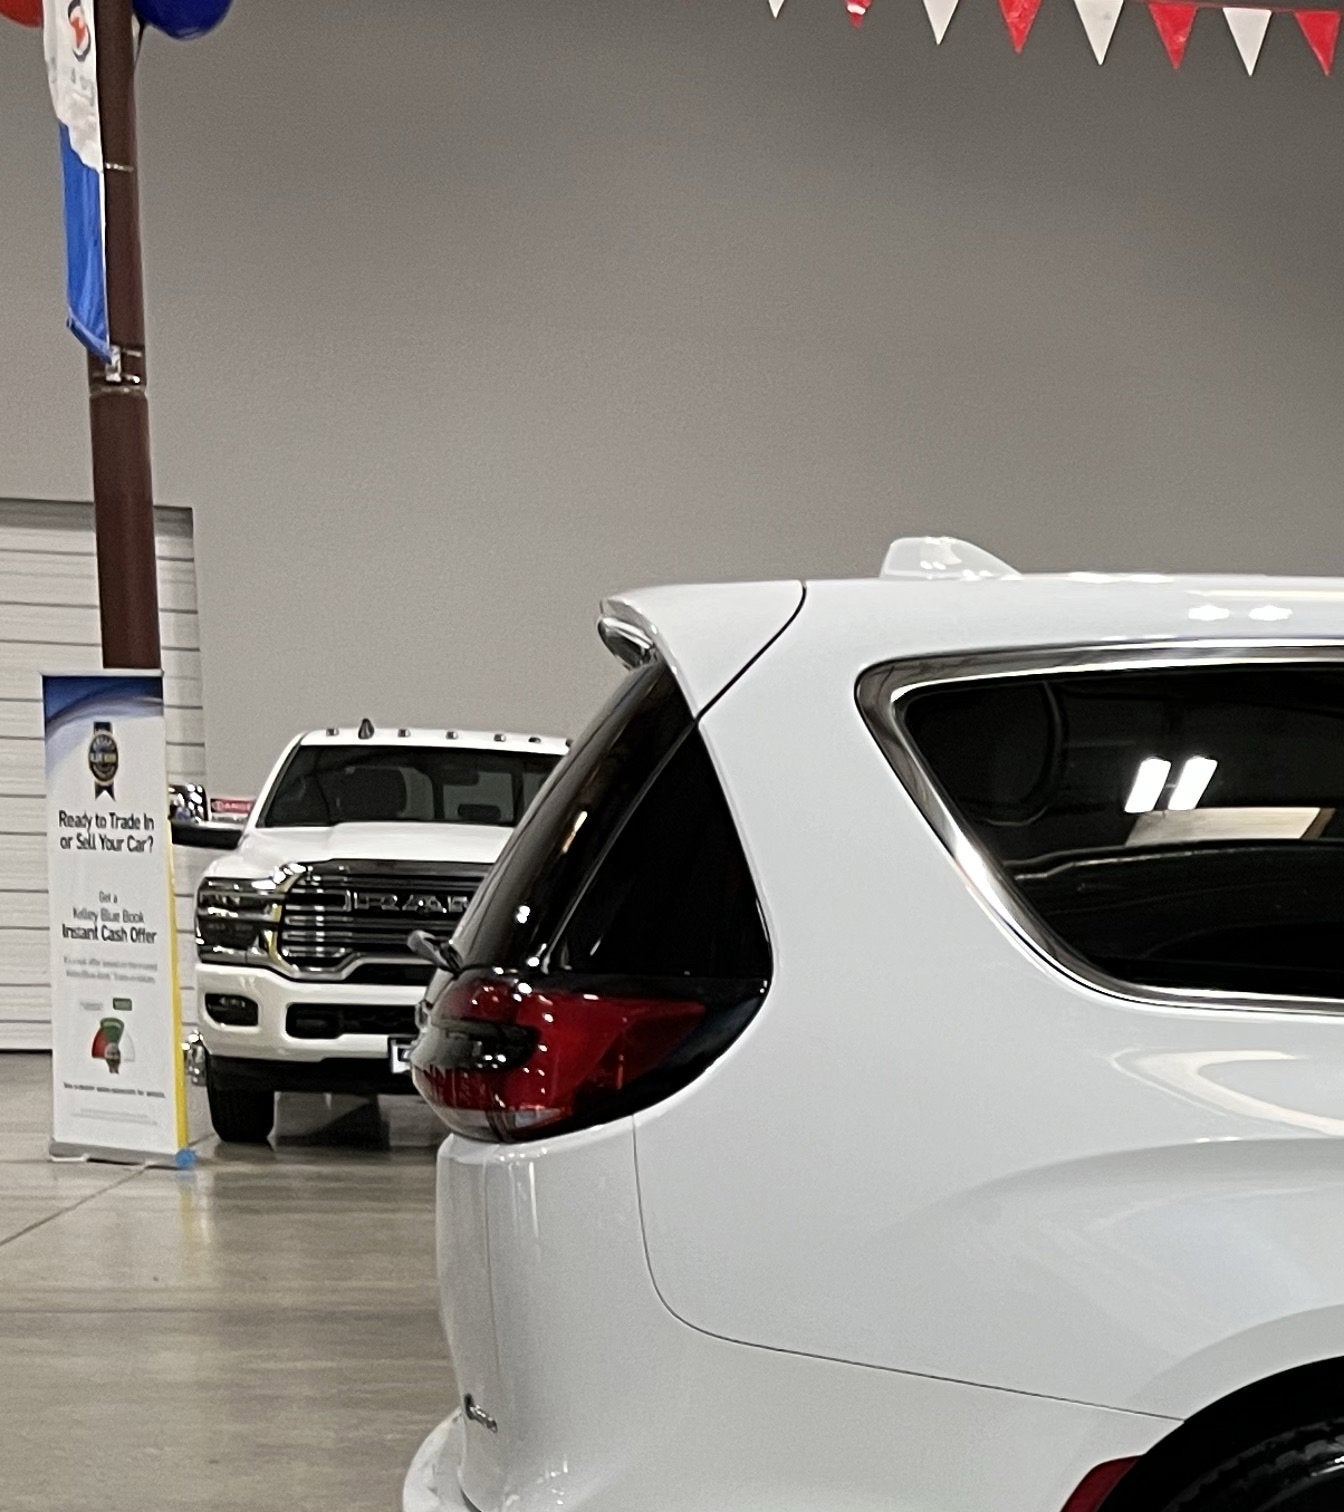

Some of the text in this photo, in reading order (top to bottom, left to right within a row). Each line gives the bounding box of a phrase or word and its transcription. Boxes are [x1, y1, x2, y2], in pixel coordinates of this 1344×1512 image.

[59, 810, 154, 832] Ready to Trade In
[60, 833, 154, 853] or Sell Your Car?
[101, 924, 128, 942] Cash
[130, 926, 157, 944] Offer
